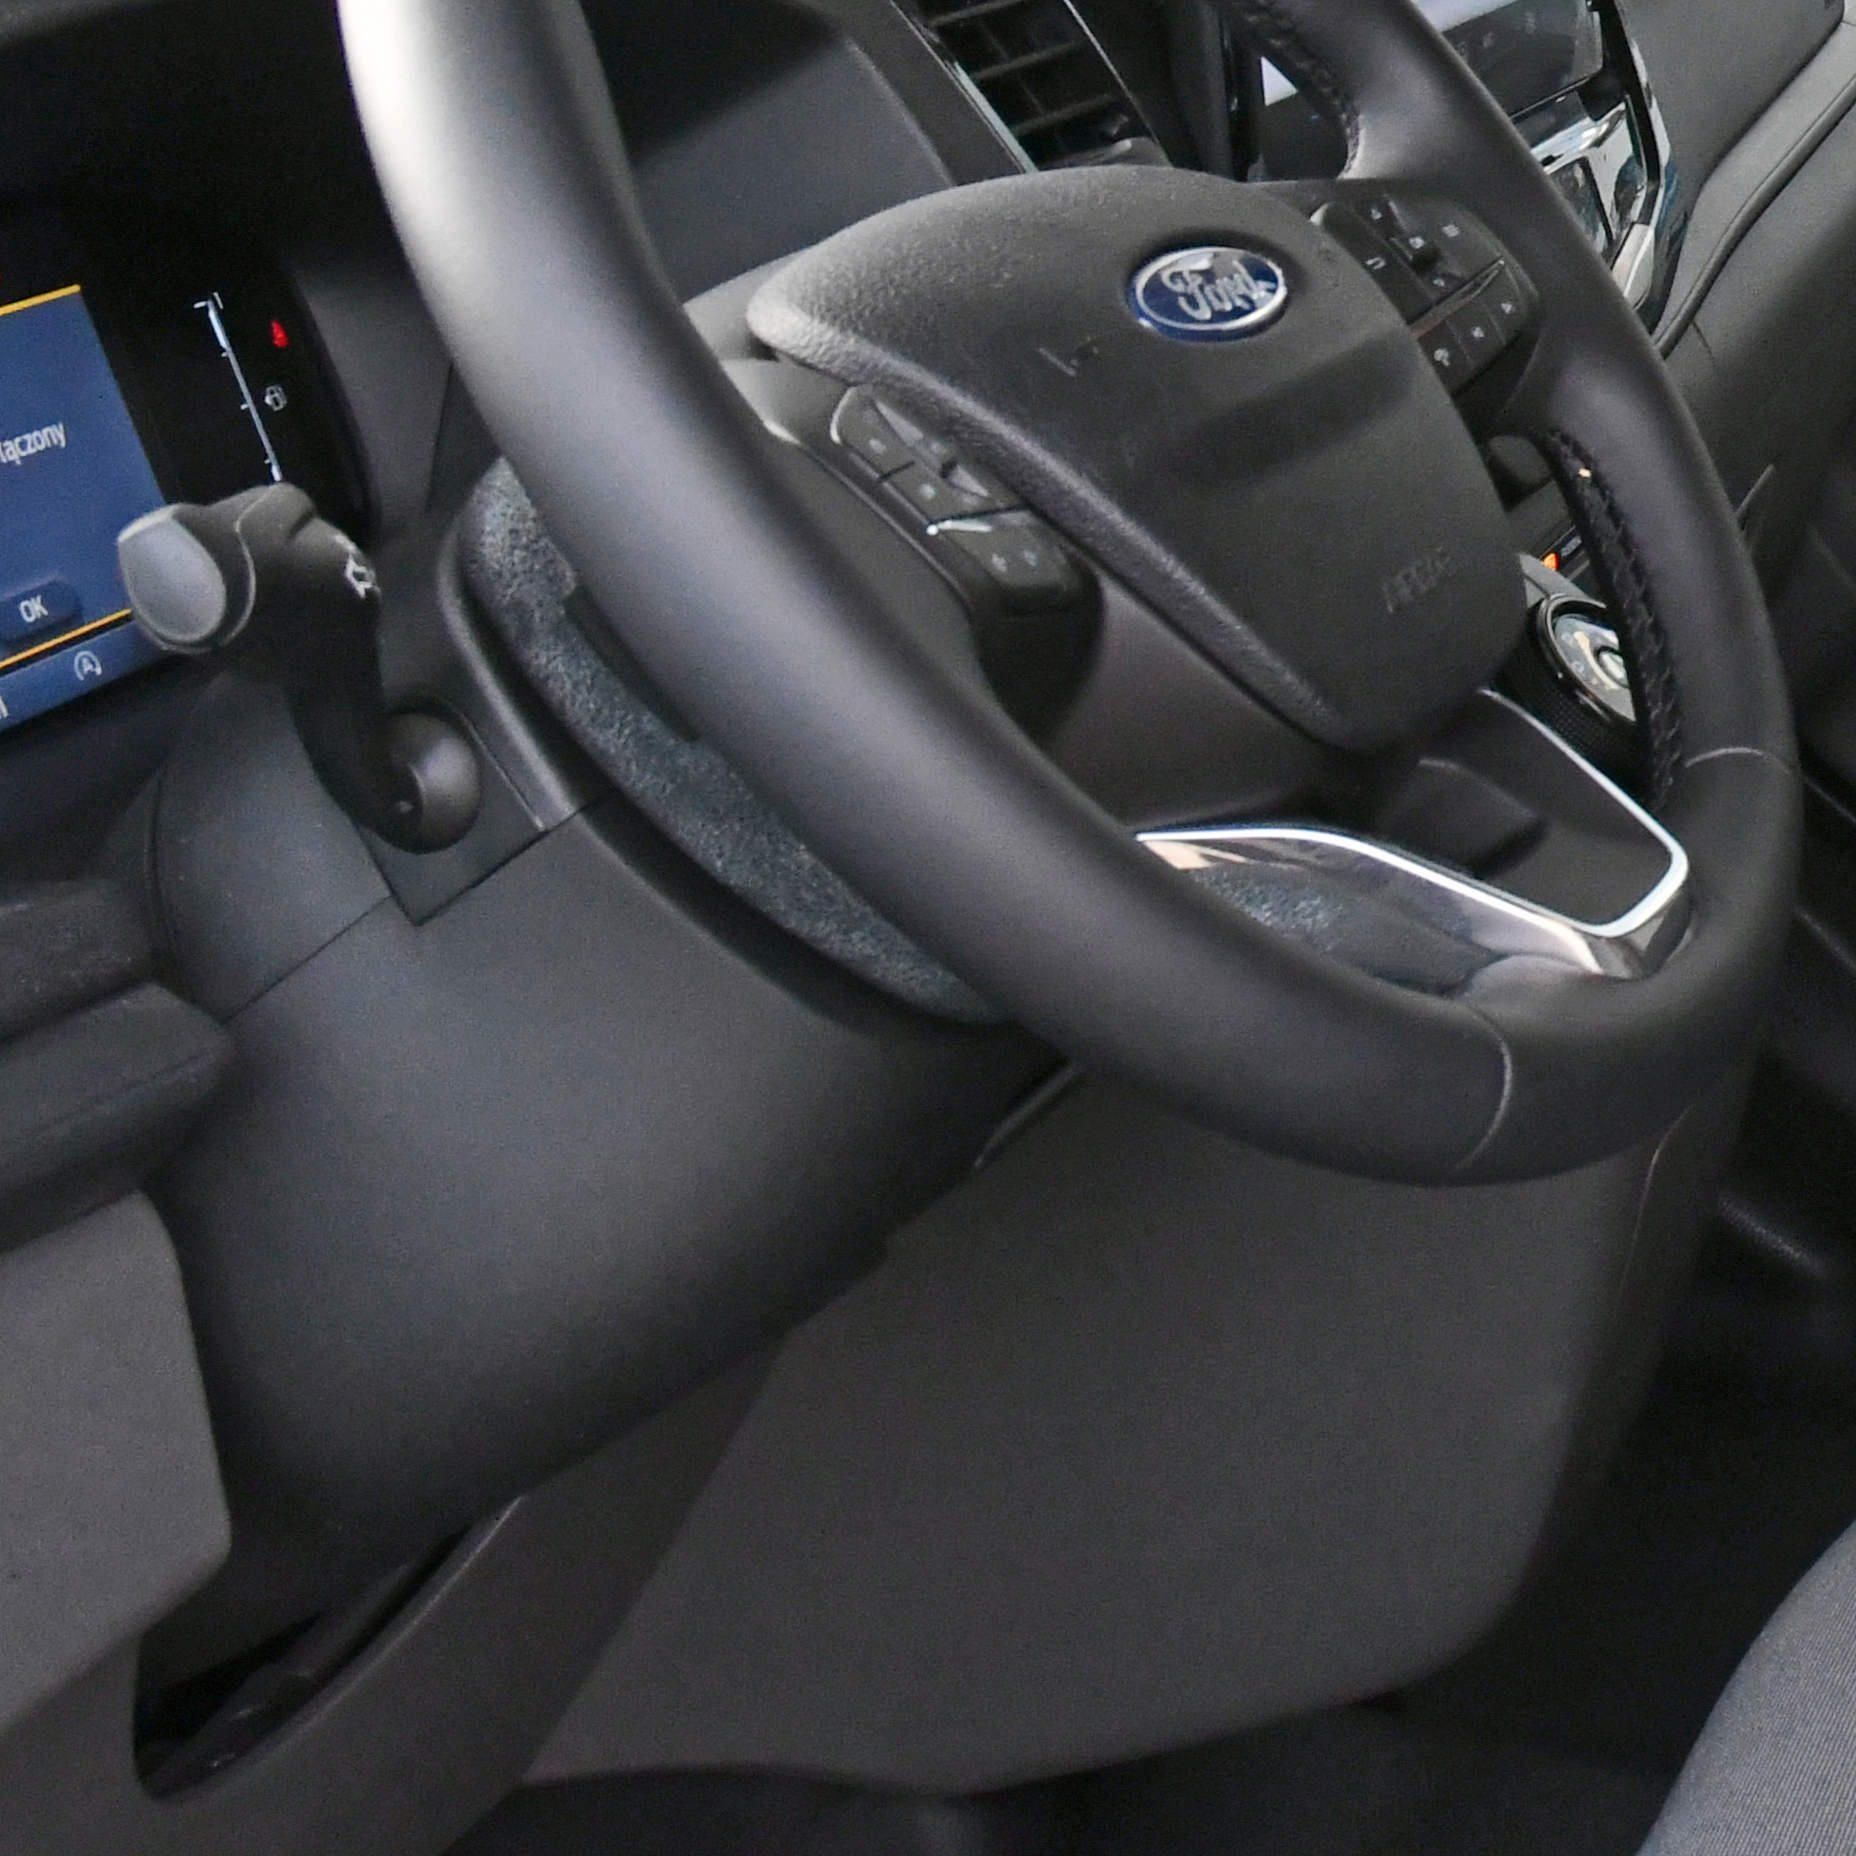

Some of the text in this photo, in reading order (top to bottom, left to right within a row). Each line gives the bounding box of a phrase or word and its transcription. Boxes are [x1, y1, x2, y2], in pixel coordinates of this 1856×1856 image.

[1160, 251, 1277, 321] Ford
[0, 422, 67, 466] łączony
[18, 593, 50, 624] OK
